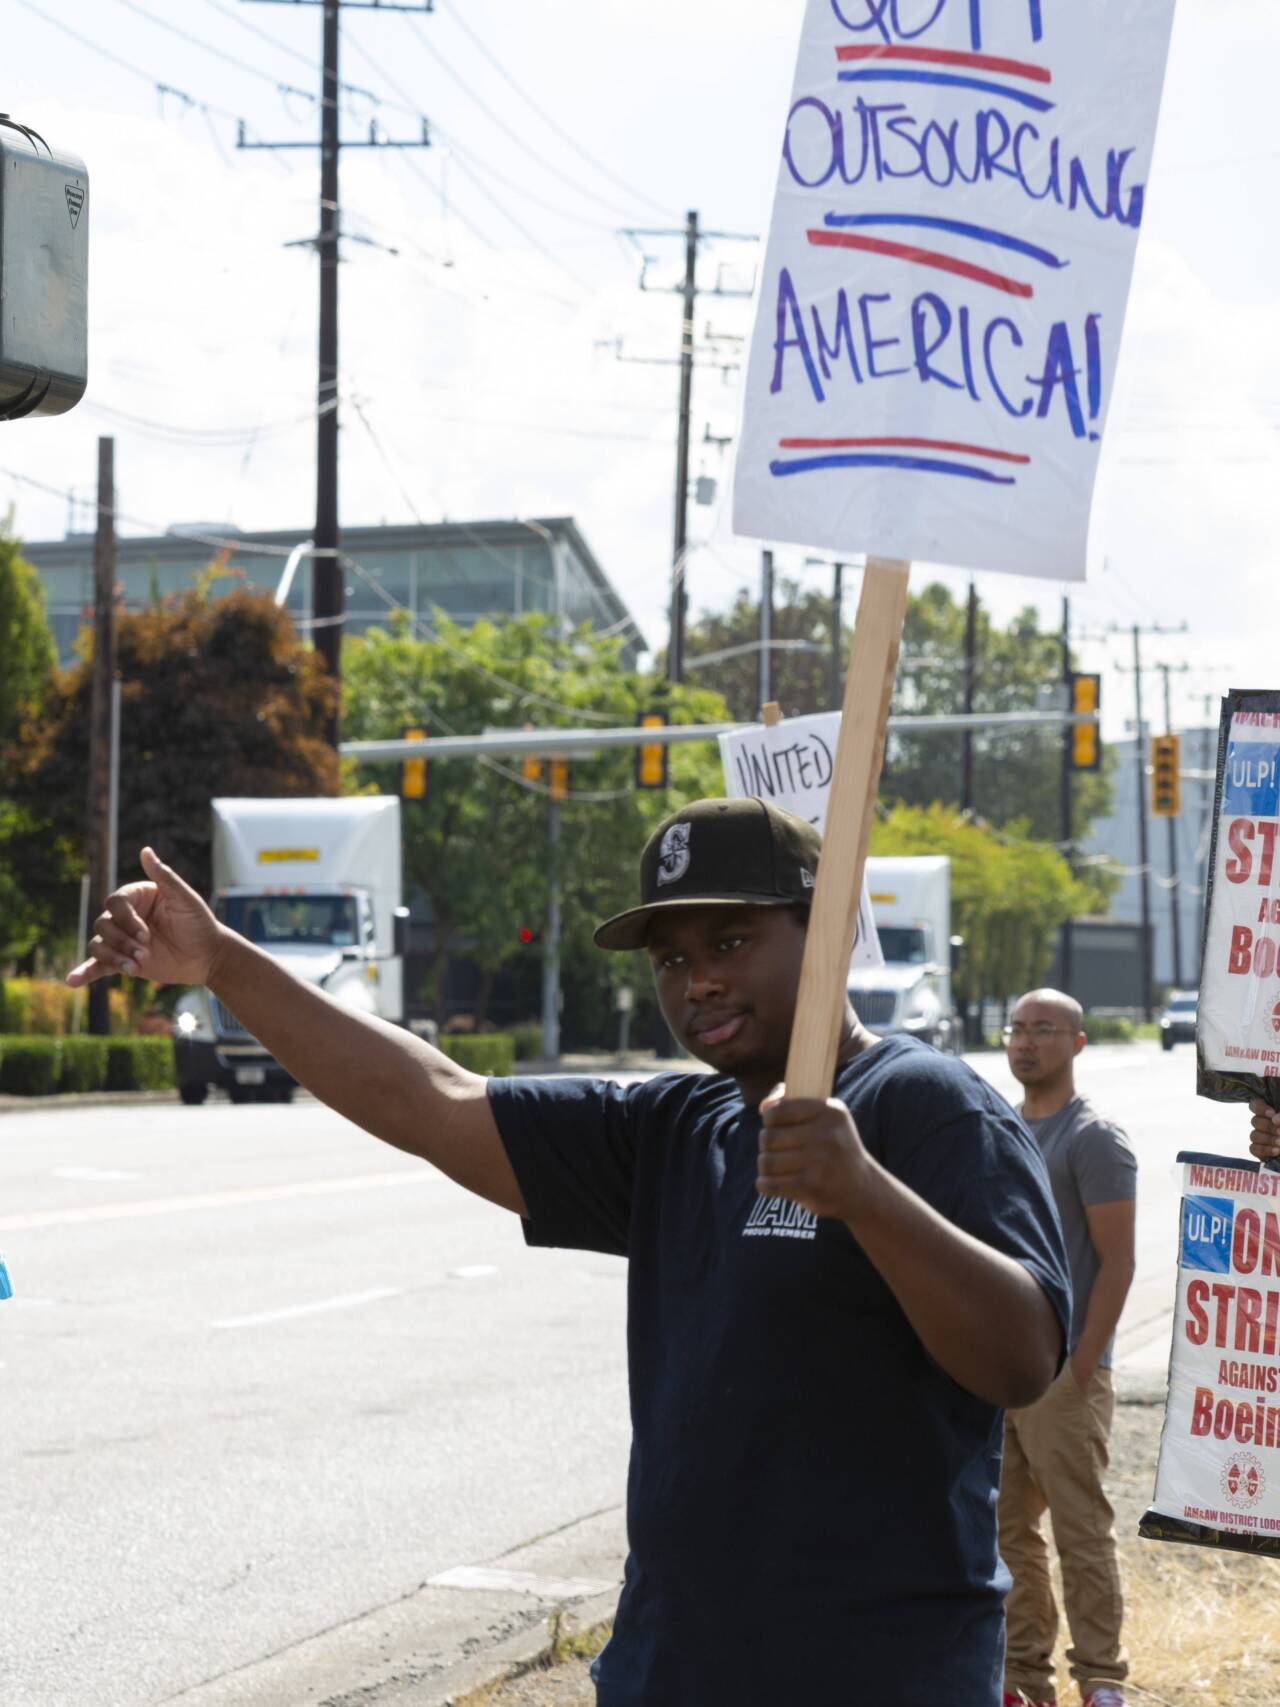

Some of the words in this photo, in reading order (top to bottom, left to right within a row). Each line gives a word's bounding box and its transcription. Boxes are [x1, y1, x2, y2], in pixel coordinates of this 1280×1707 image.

[782, 96, 1144, 229] OUTSOURCING
[770, 267, 1101, 442] AMERICA!
[736, 733, 834, 797] UNITED
[1232, 760, 1276, 788] ULP!
[741, 1227, 771, 1237] PROUD
[772, 1228, 817, 1240] MEMBER
[1187, 1213, 1228, 1245] ULP!
[1220, 1511, 1259, 1528] DISTRICT
